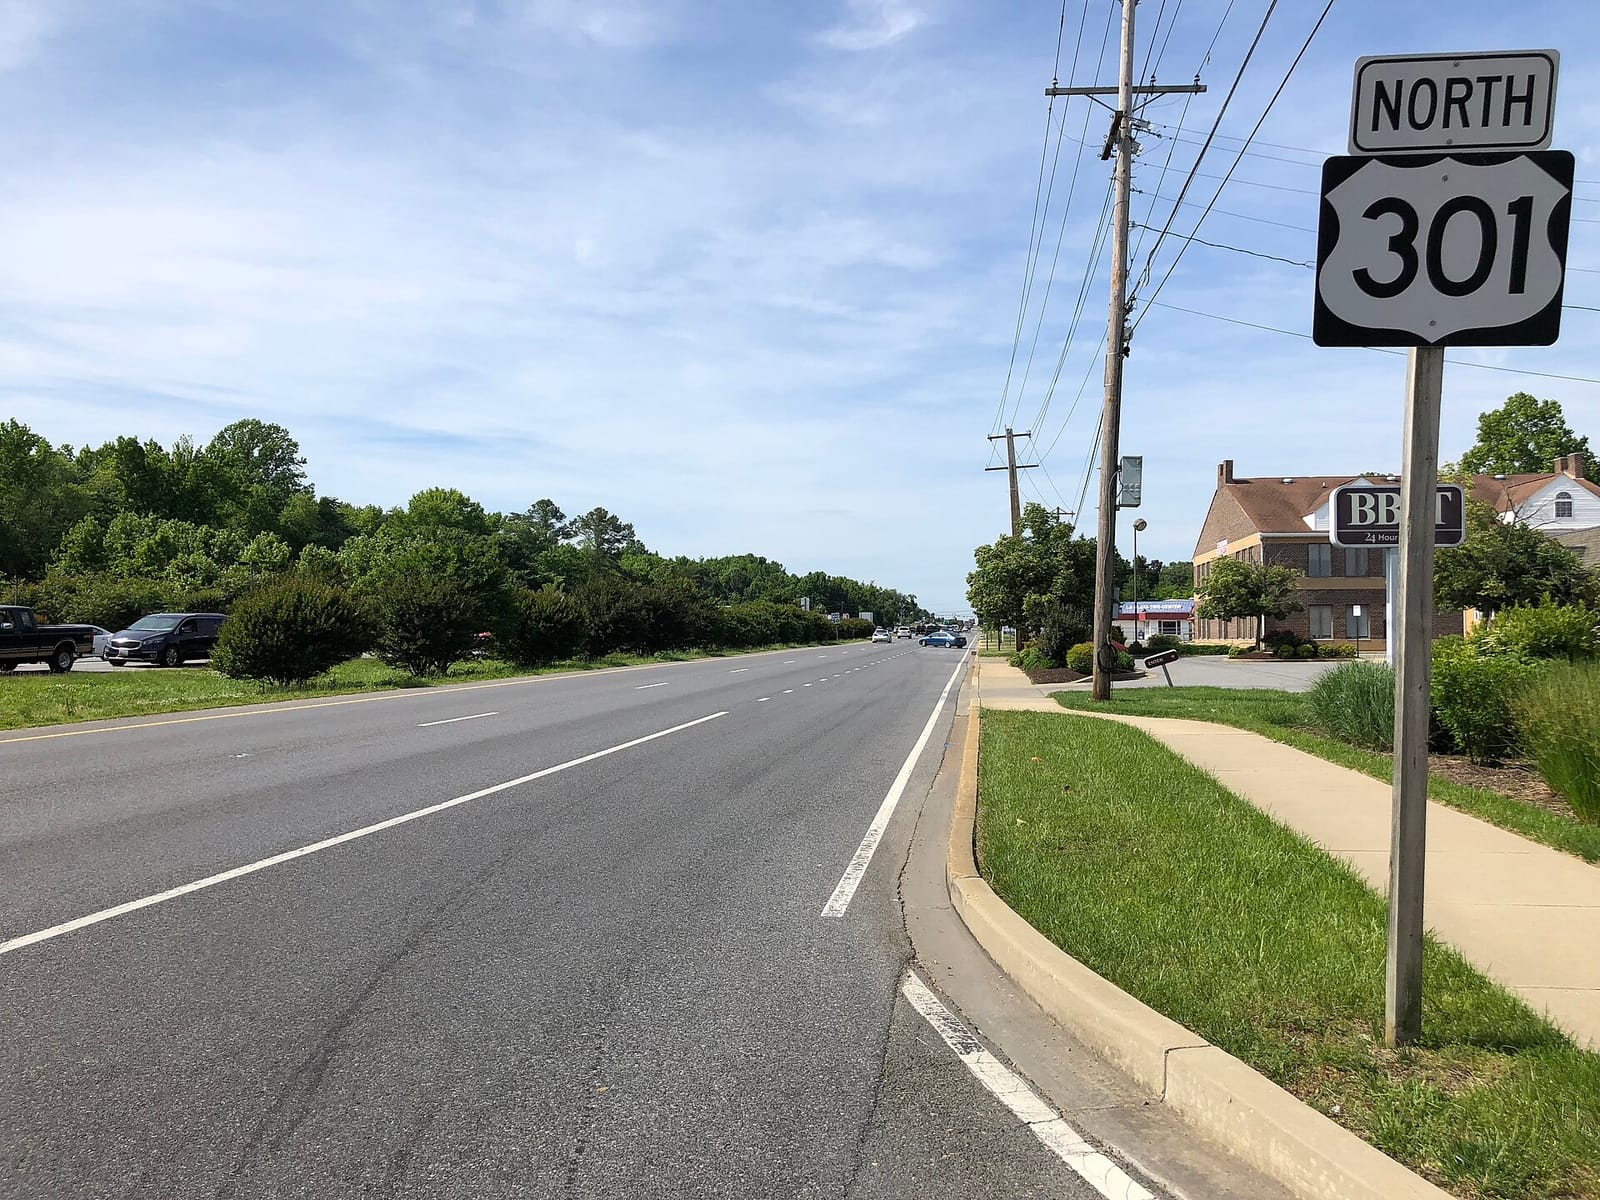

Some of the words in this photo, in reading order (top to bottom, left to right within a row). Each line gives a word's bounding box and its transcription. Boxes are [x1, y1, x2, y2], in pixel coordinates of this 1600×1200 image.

[1371, 74, 1536, 132] NORTH
[1352, 195, 1534, 299] 301
[1347, 492, 1452, 526] BBT
[1365, 533, 1376, 543] 24
